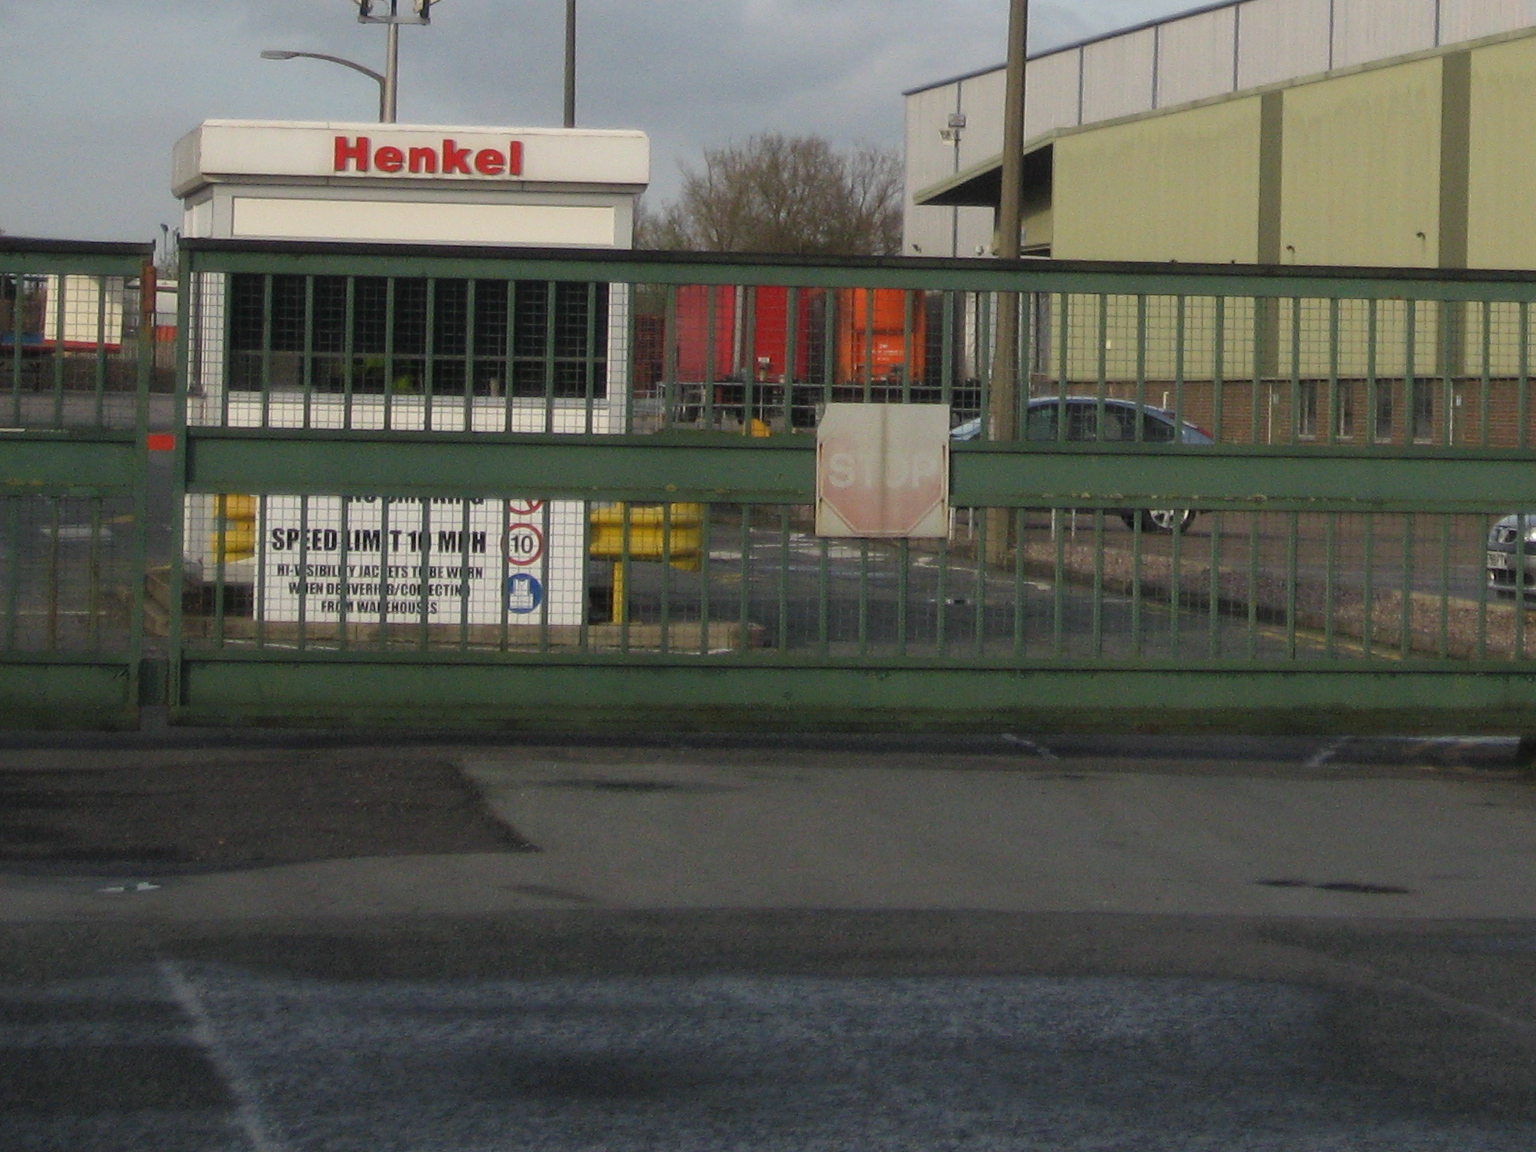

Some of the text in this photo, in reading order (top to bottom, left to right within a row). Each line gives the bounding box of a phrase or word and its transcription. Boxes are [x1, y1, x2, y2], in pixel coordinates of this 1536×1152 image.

[334, 136, 524, 176] Henkel
[829, 453, 938, 488] STOP
[344, 529, 402, 552] LIMT
[511, 535, 533, 553] 10
[277, 564, 356, 579] HI-VSIBILIY
[358, 565, 409, 579] JACETS
[446, 567, 484, 580] WRN
[356, 601, 438, 615] WAEHOUSS
